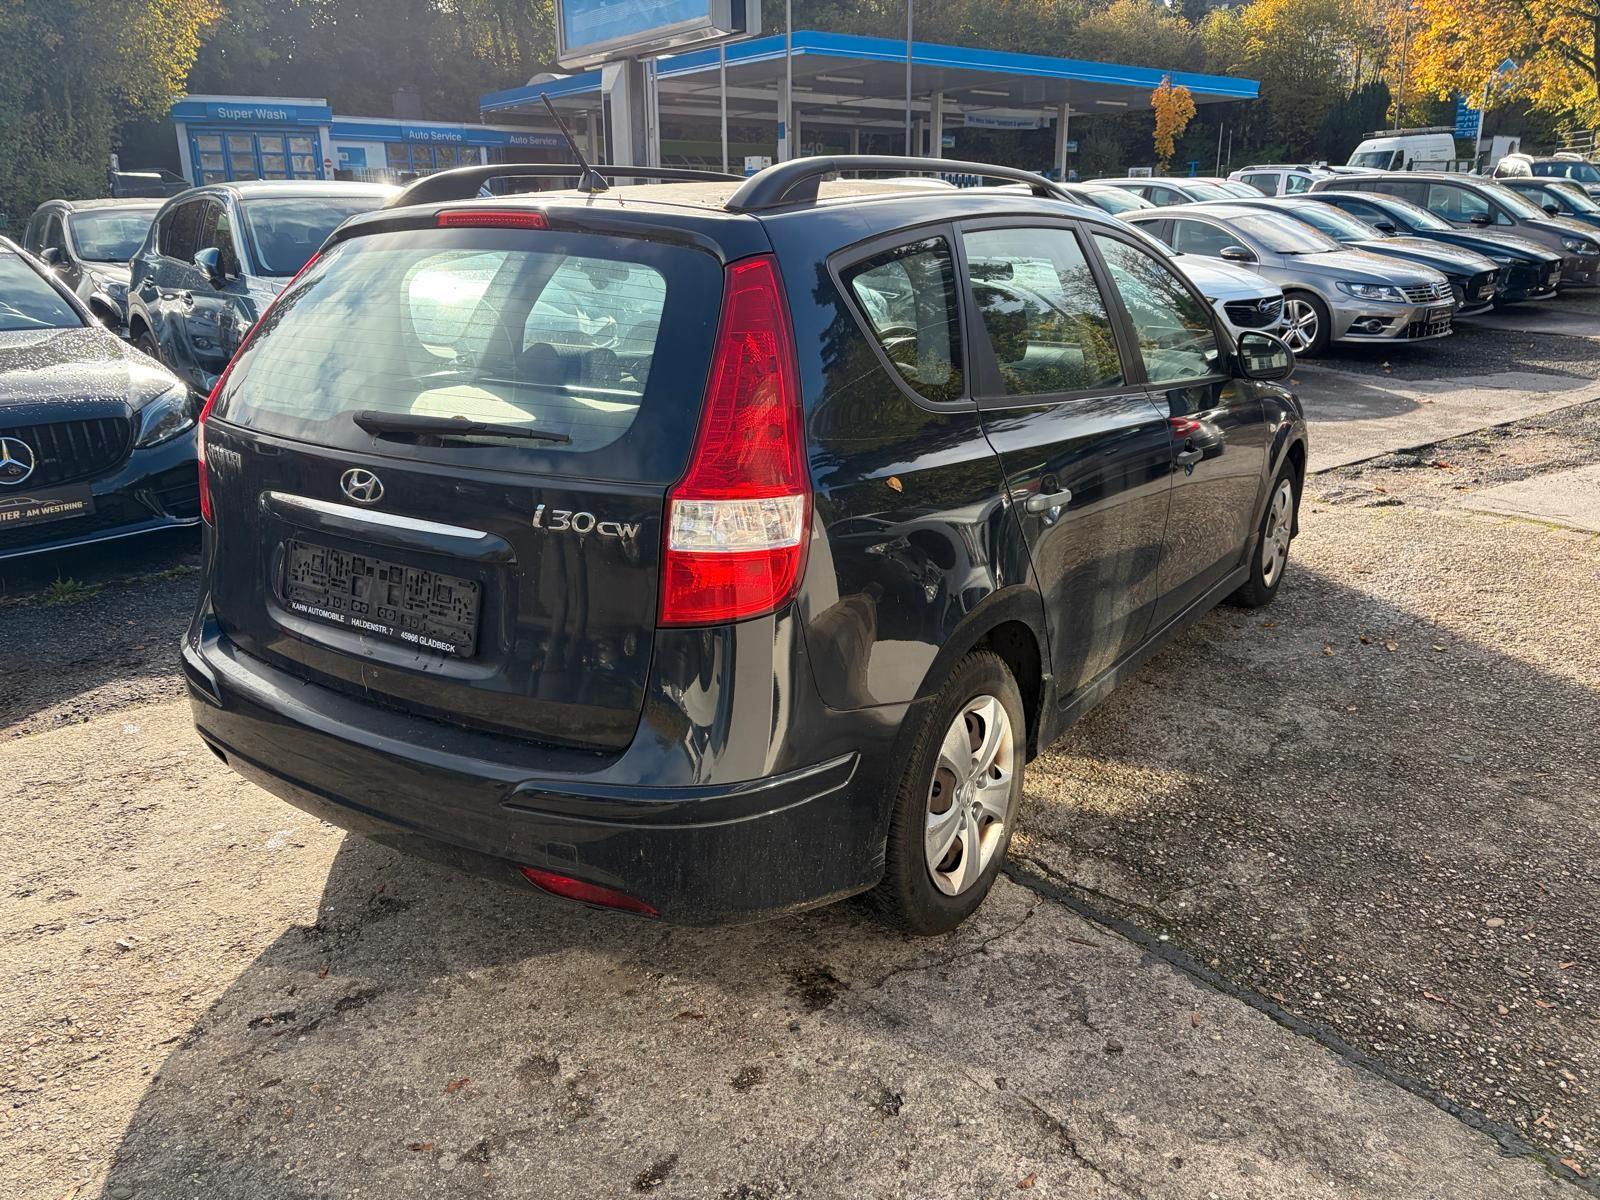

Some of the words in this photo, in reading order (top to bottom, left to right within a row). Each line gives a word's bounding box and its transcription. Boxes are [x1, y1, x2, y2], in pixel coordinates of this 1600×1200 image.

[217, 107, 254, 121] Super
[255, 108, 288, 120] Wash
[408, 129, 429, 140] Auto
[430, 131, 462, 142] Service
[509, 135, 528, 145] Auto
[529, 136, 558, 146] Service
[0, 510, 20, 521] TER
[26, 508, 40, 518] AM
[41, 501, 83, 515] WESTRING
[291, 602, 308, 613] KAHN
[307, 606, 345, 623] AUTOMOBILE
[351, 617, 389, 635] HALDENSTR.
[389, 627, 394, 636] 7
[419, 636, 456, 653] GLADBECK
